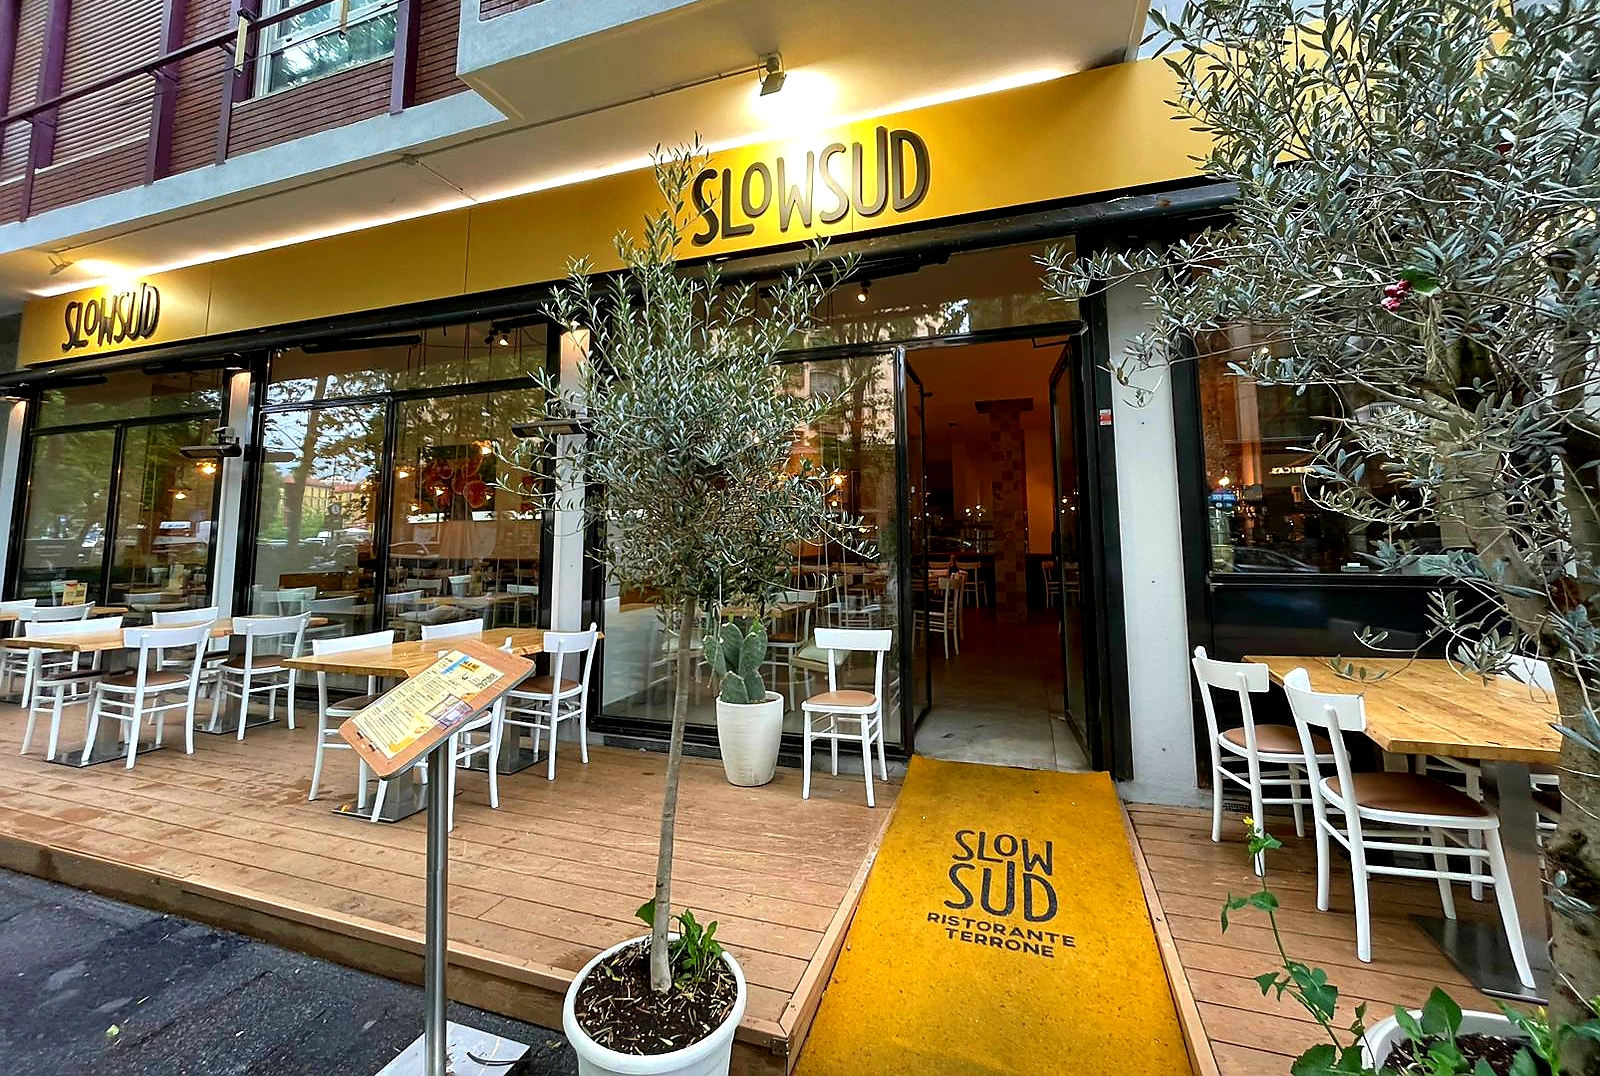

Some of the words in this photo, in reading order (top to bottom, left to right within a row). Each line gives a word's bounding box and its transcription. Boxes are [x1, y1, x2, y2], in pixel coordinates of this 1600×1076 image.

[691, 126, 931, 246] SLOWSUD
[61, 282, 160, 352] SLOWSUD
[952, 829, 1053, 876] SLOW
[943, 860, 1058, 922] SUD
[927, 912, 1076, 948] RISTORANTE
[945, 927, 1055, 958] TERRONE
